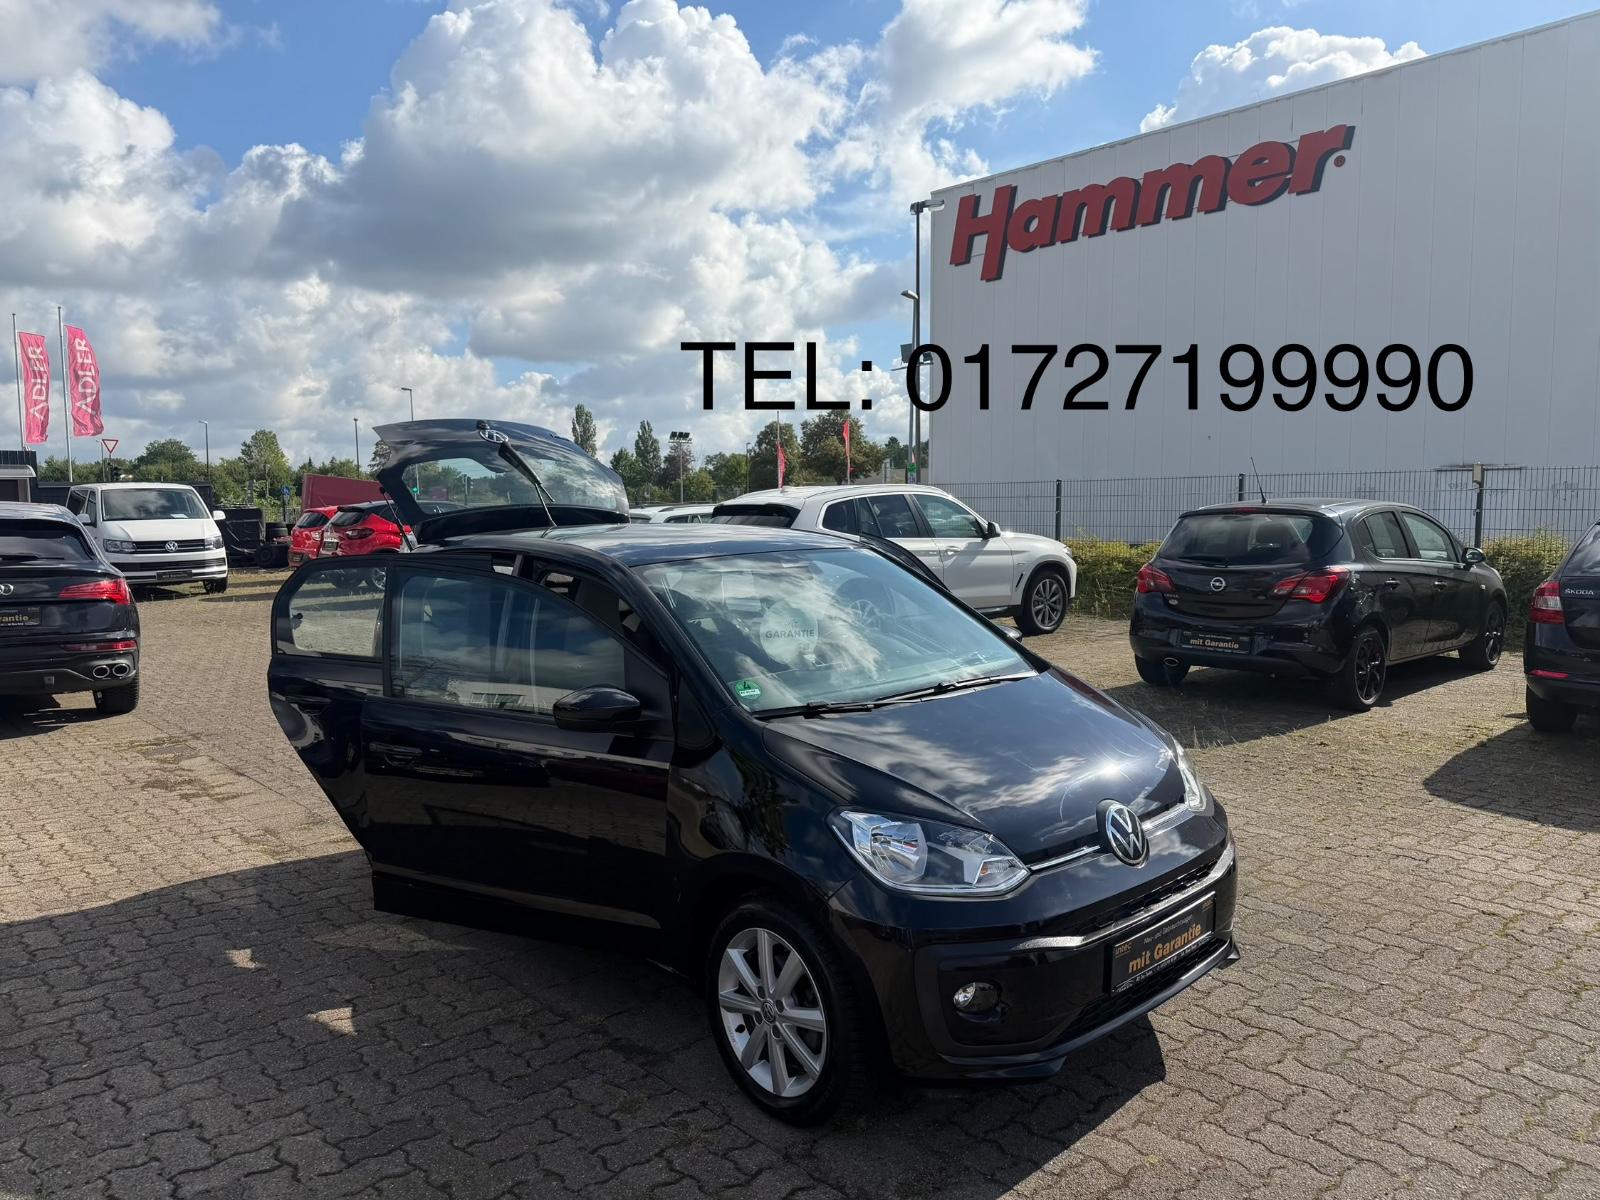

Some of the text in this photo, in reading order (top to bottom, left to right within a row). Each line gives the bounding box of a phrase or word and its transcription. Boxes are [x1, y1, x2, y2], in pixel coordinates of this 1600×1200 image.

[28, 345, 49, 420] ADLER
[75, 338, 97, 415] ADLER
[765, 629, 815, 639] GARANTIE
[1190, 638, 1204, 646] mit
[1204, 638, 1240, 649] Garantie
[743, 681, 751, 690] 4
[1128, 951, 1152, 974] mit
[1153, 923, 1202, 960] Garantie
